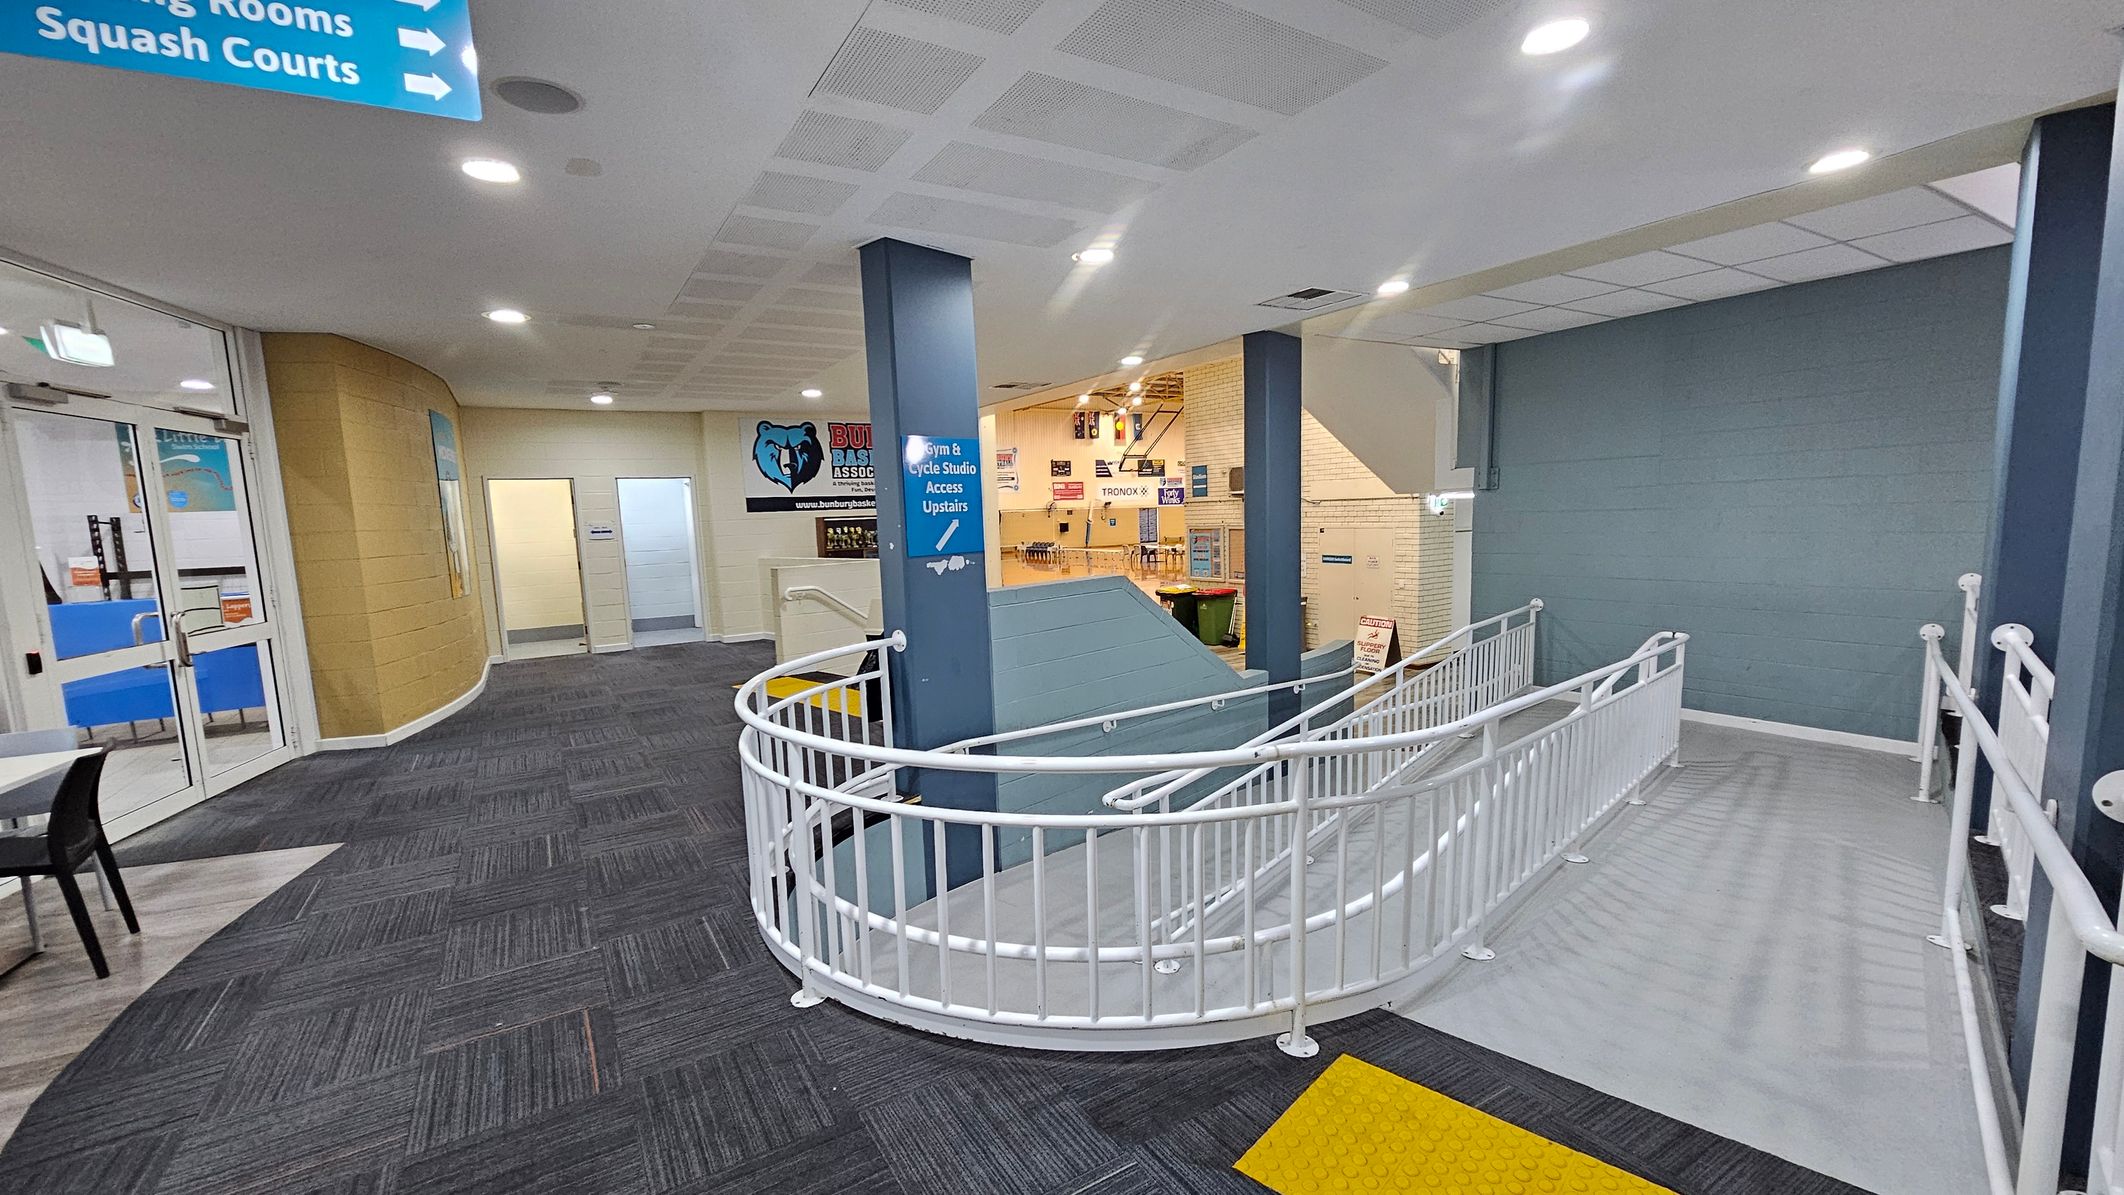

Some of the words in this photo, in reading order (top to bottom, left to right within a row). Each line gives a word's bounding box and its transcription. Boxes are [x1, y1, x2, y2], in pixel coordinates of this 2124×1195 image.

[36, 5, 210, 63] Squash
[222, 36, 361, 85] Courts
[925, 442, 950, 458] Gym
[952, 442, 961, 456] &
[833, 466, 874, 478] ASSOC
[908, 460, 941, 478] Cycle
[942, 461, 977, 475] Studio
[926, 481, 963, 494] Access
[1102, 487, 1138, 497] TRONOX
[923, 499, 969, 516] Upstairs
[1361, 618, 1392, 628] CAUTION
[1357, 641, 1386, 649] SLIPPERY
[1357, 656, 1380, 664] CLEANING
